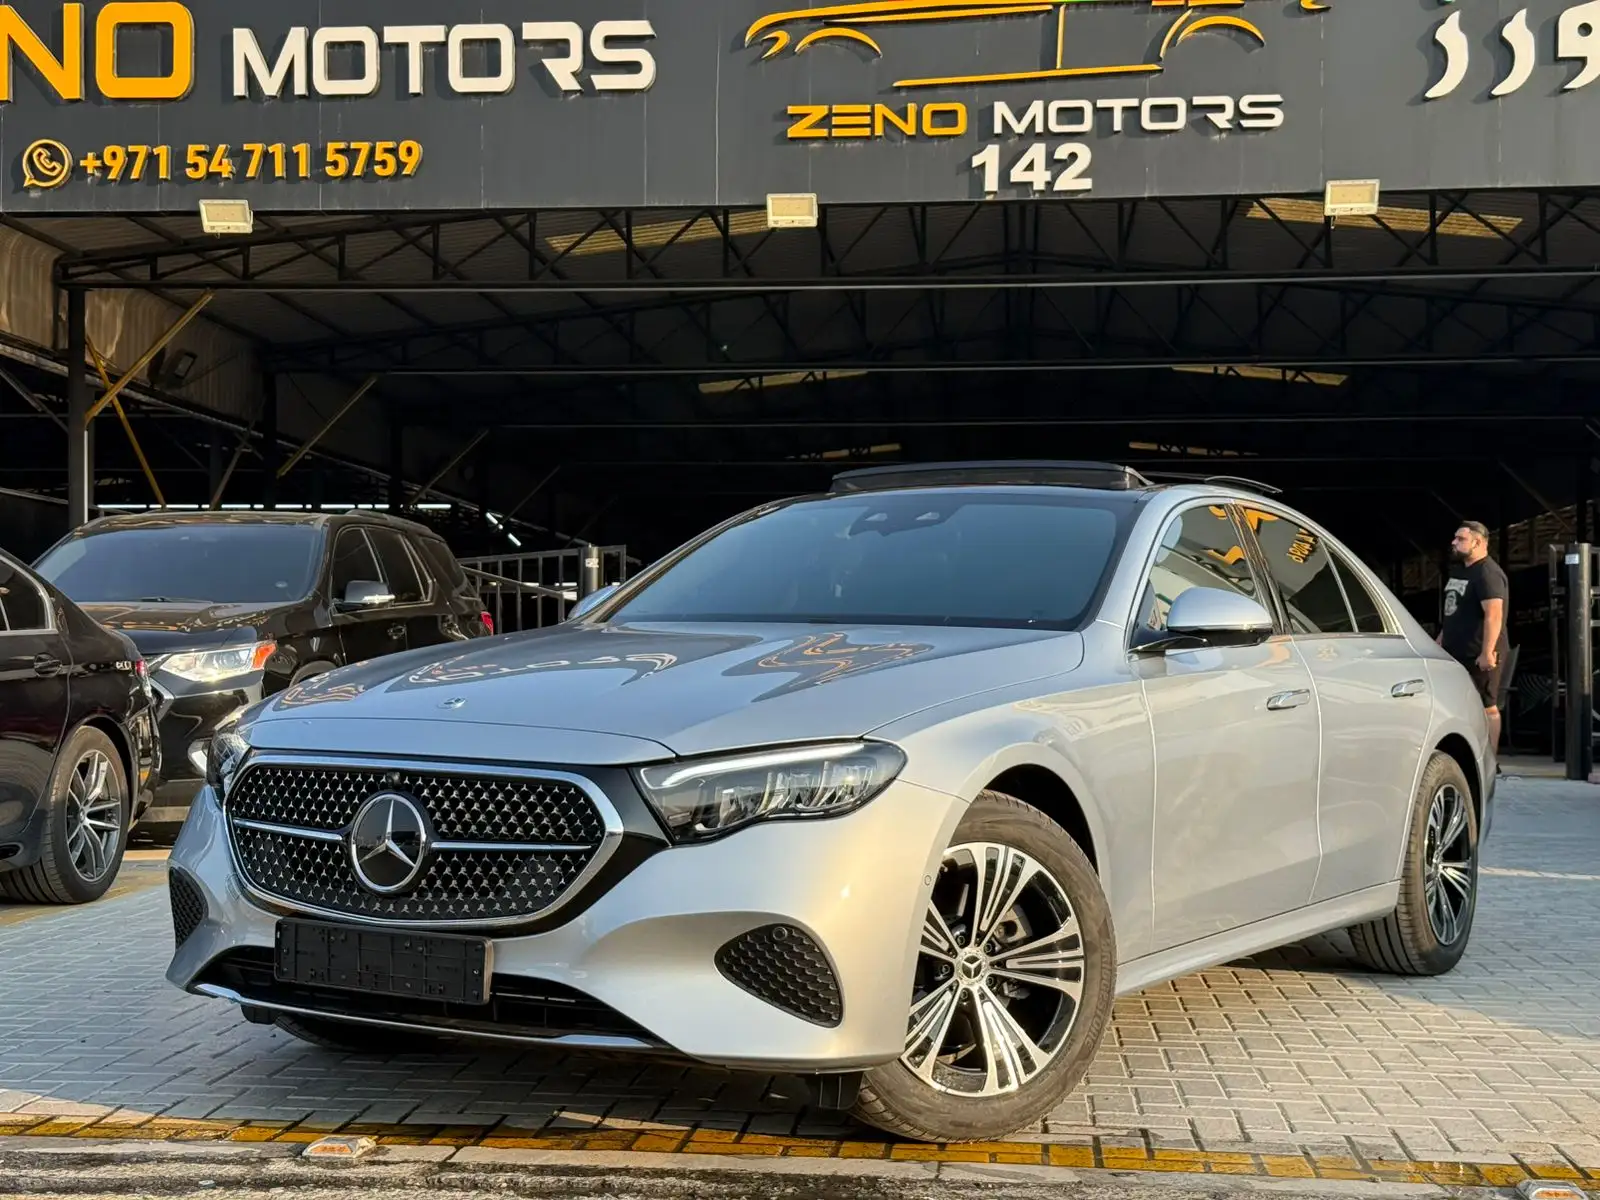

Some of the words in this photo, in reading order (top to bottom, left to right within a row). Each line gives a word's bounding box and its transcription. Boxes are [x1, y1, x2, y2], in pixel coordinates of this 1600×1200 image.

[233, 20, 655, 97] MOTORS
[787, 103, 967, 138] ZENO
[993, 94, 1284, 135] MOTORS
[79, 145, 169, 181] +971
[185, 146, 234, 180] 54
[242, 144, 309, 178] 711
[324, 139, 423, 177] 5759
[970, 142, 1093, 192] 142
